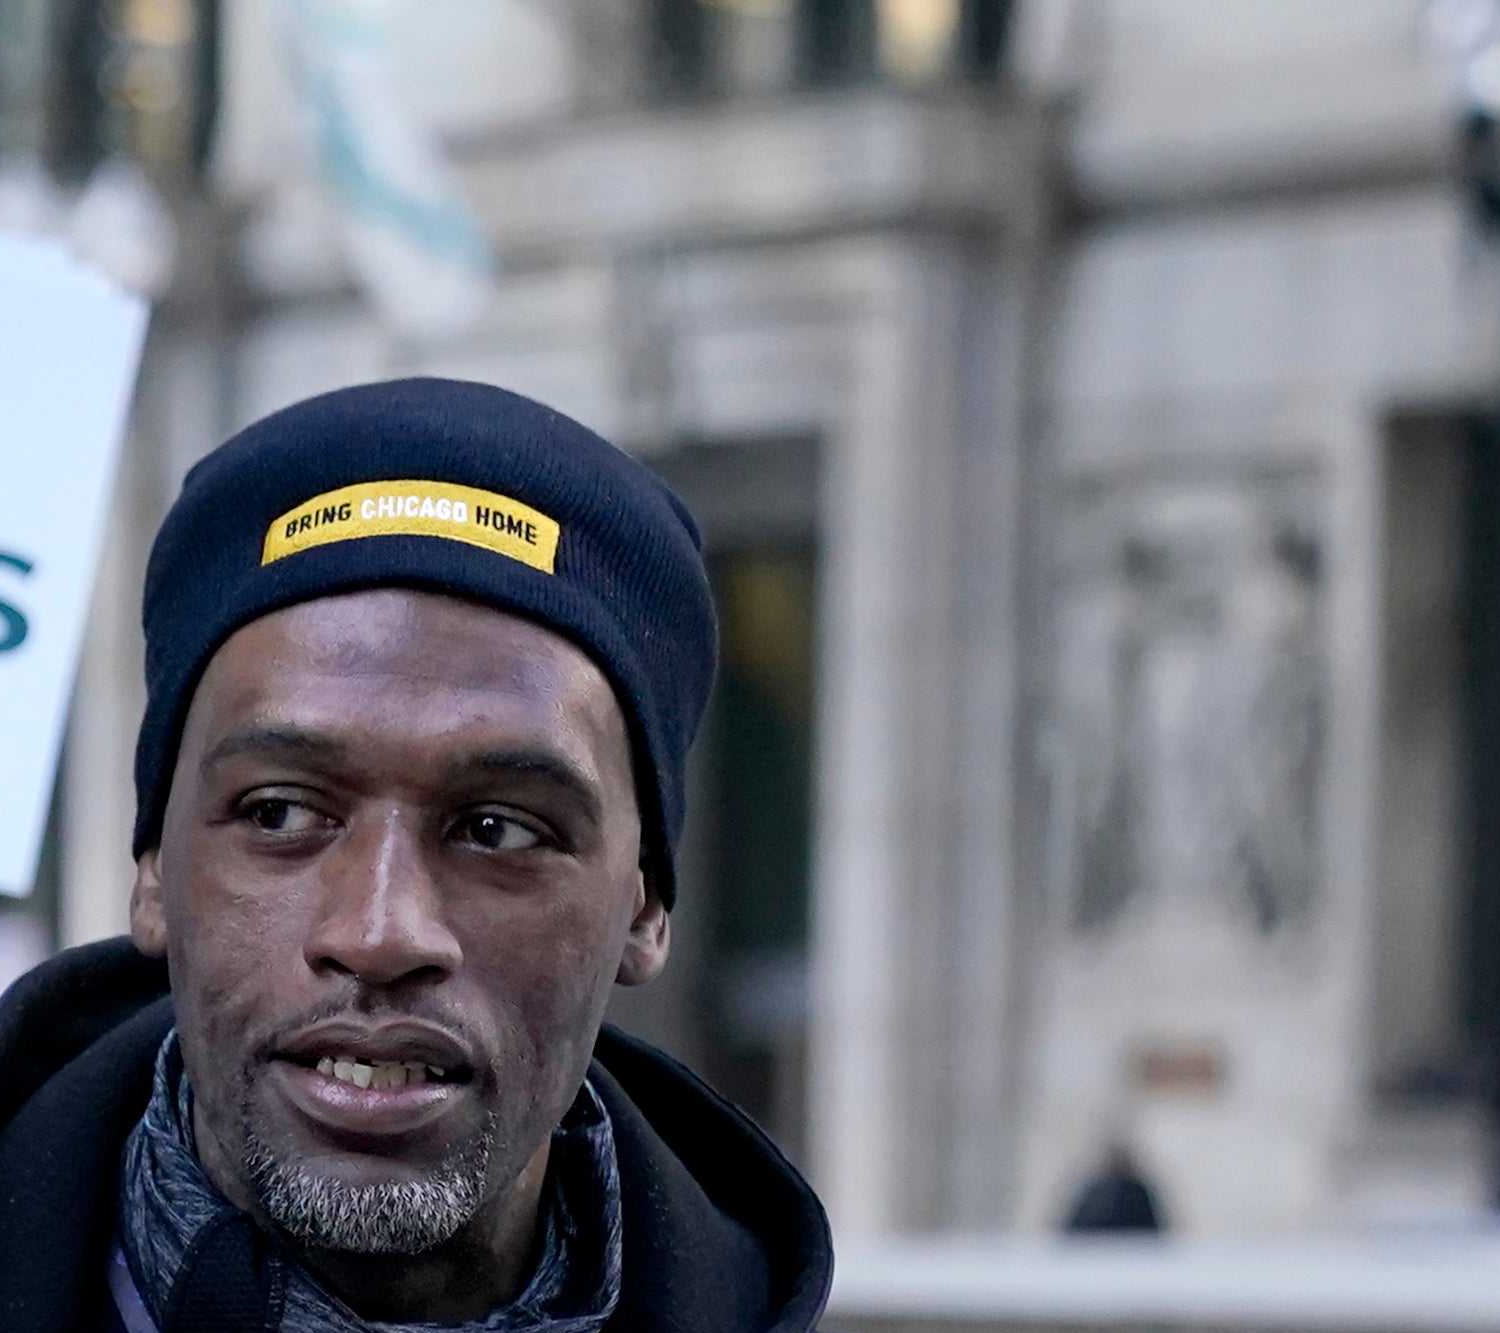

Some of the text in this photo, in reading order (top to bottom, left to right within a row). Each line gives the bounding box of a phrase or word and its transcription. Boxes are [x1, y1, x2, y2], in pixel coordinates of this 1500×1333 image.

[285, 495, 538, 547] BRING CHICAGO HOME
